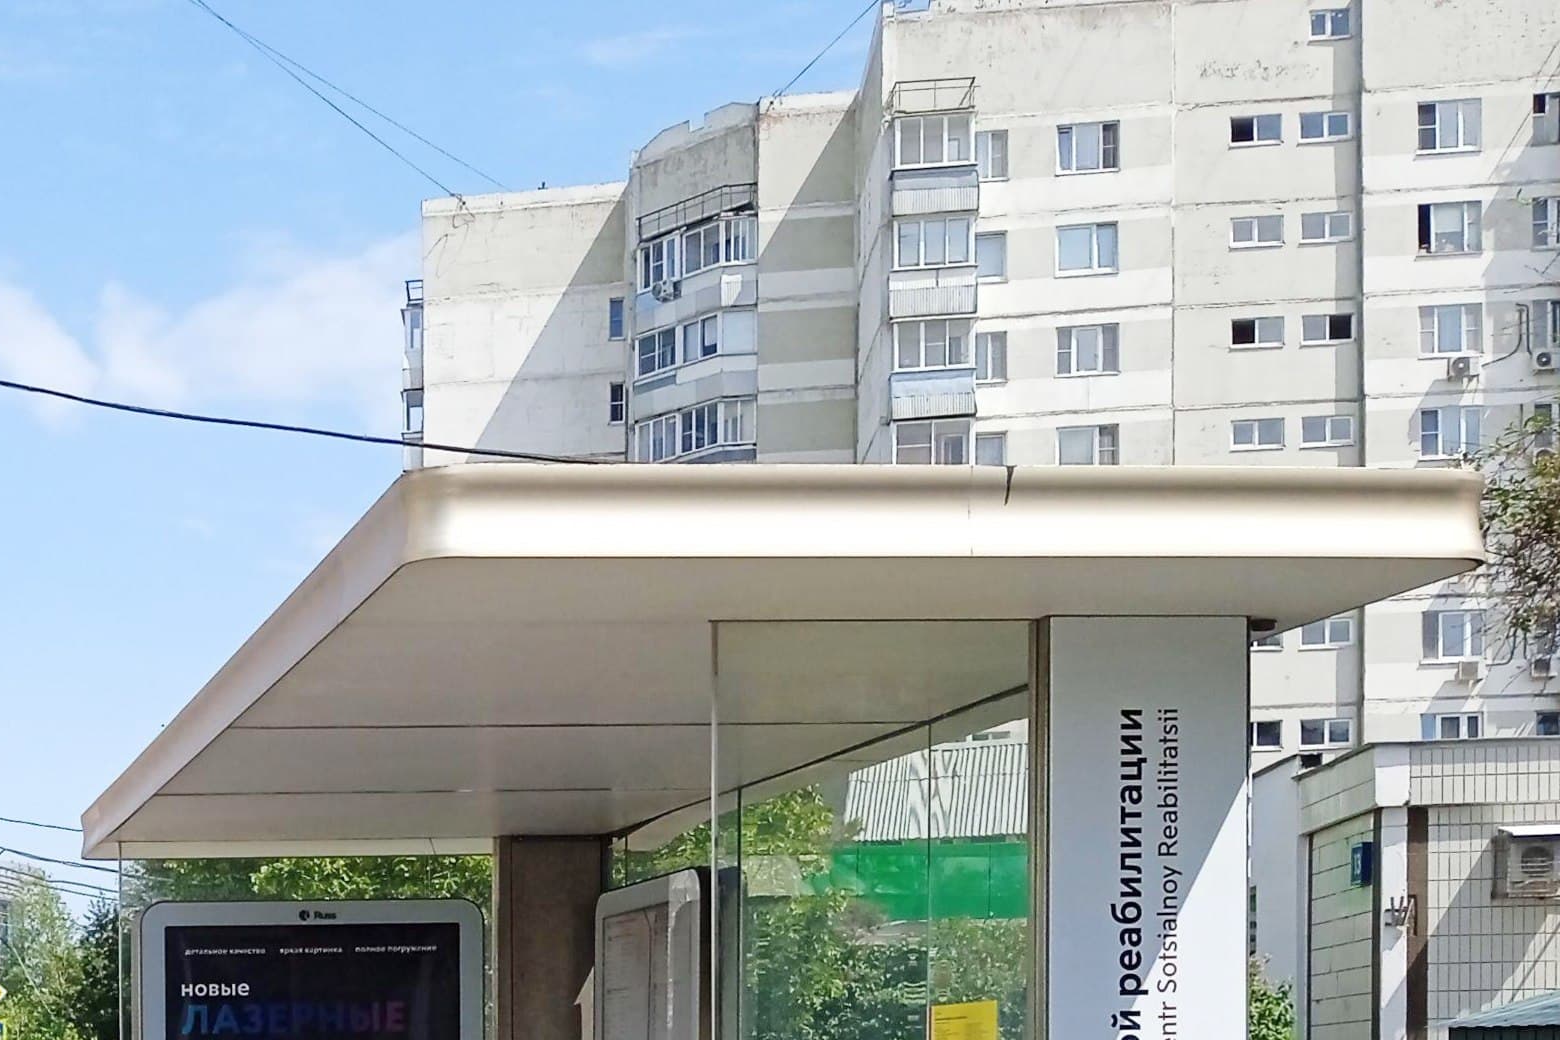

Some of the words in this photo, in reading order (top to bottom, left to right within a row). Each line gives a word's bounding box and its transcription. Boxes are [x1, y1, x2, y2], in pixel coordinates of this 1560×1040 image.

[1156, 708, 1179, 858] Reabilitatsii
[1110, 708, 1149, 997] реабилитации
[181, 981, 250, 998] новые
[1156, 864, 1184, 994] Sotsialnoy
[181, 1001, 406, 1036] ЛАЗЕРНЫЕ
